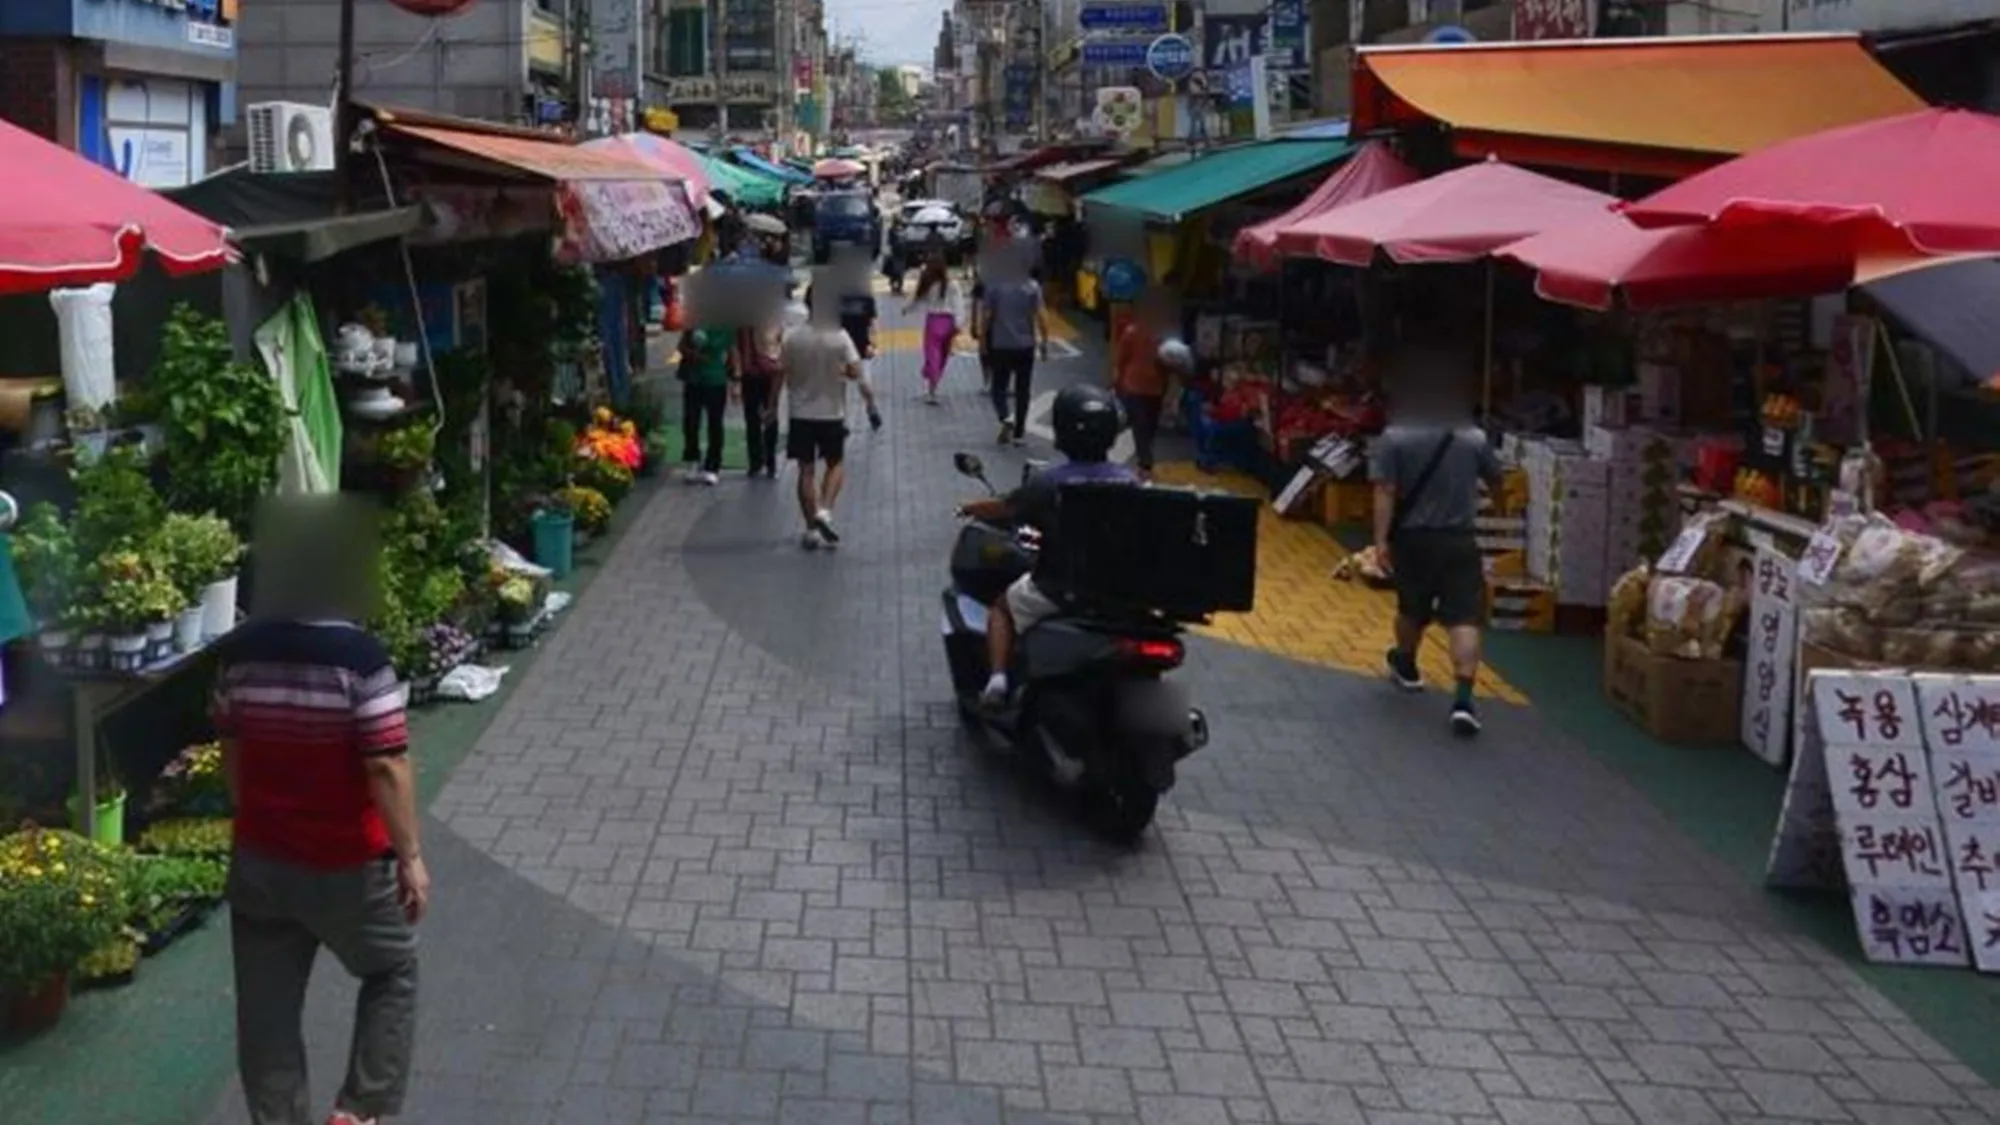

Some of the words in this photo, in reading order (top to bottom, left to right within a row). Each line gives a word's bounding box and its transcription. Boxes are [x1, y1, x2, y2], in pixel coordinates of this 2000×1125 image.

[1835, 689, 1903, 740] 녹용
[1850, 752, 1918, 808] 홍삼
[1961, 836, 2000, 890] 추
[1870, 894, 1960, 959] 흑염소
